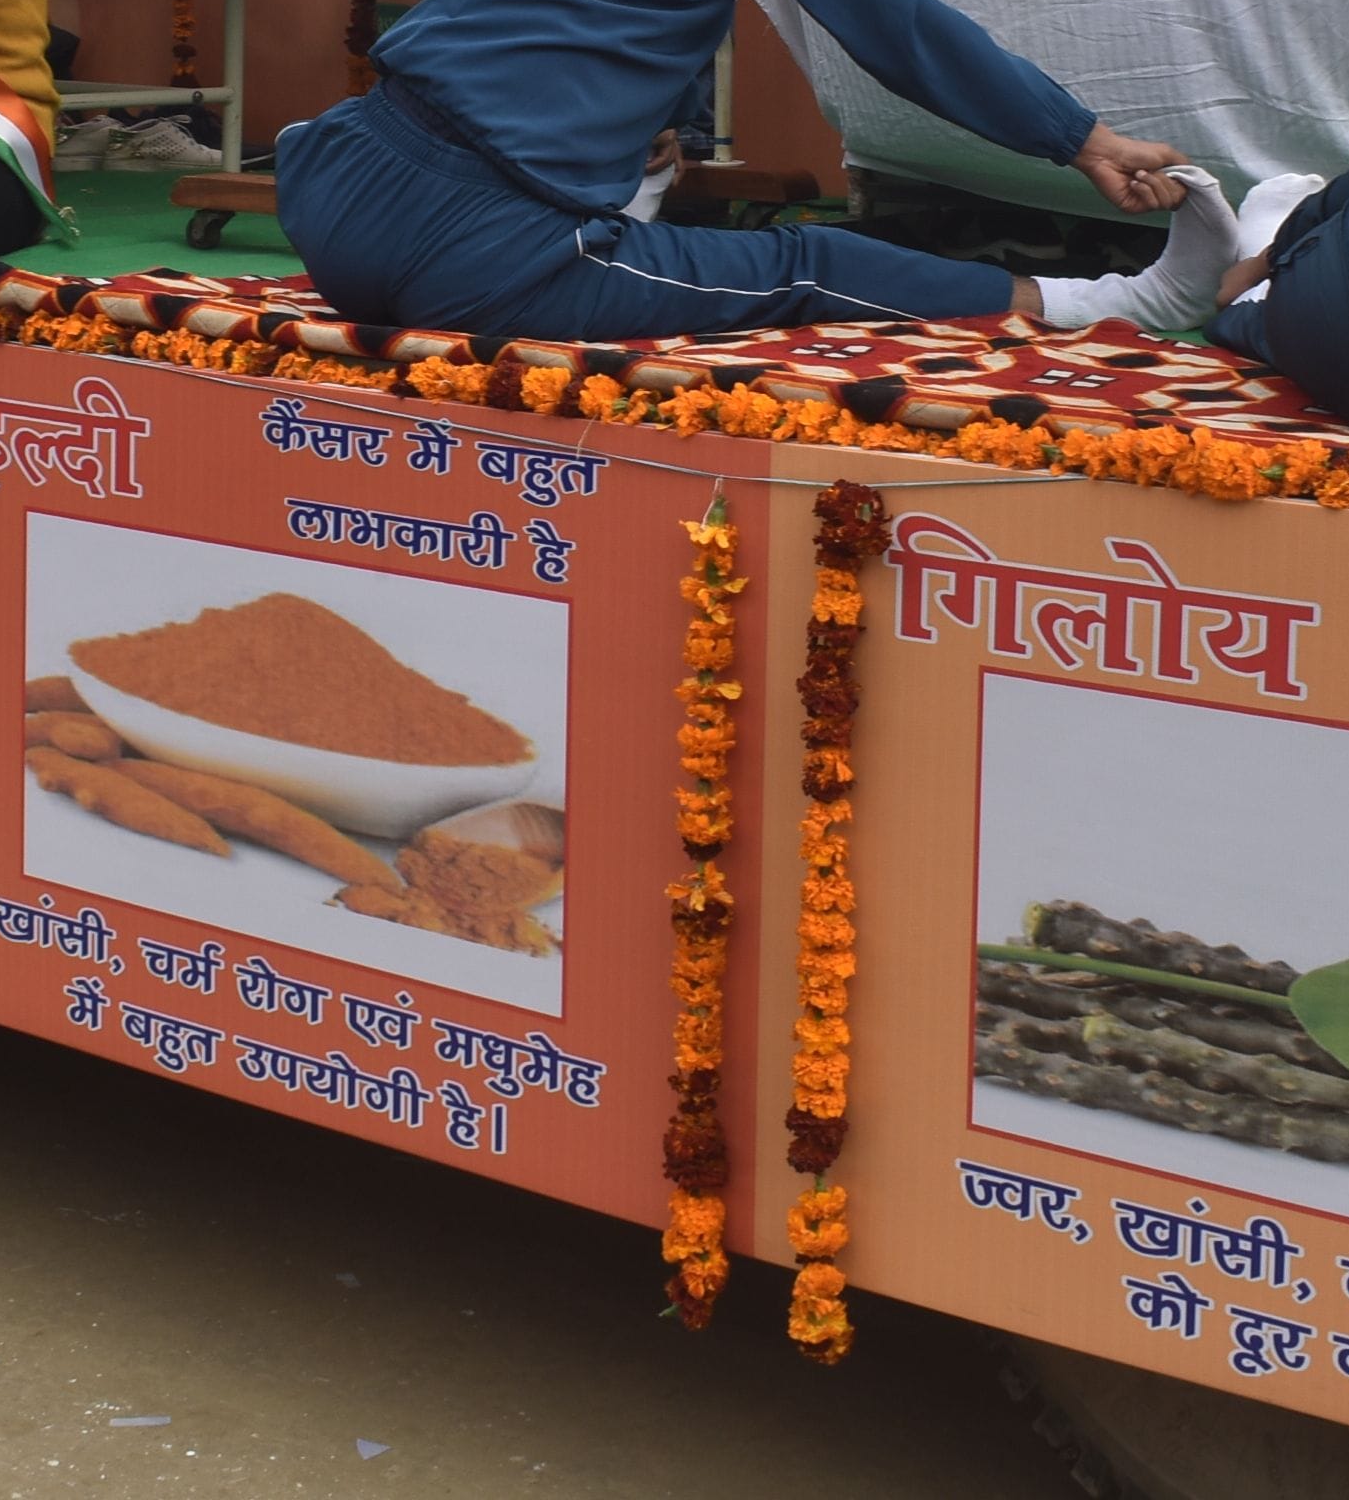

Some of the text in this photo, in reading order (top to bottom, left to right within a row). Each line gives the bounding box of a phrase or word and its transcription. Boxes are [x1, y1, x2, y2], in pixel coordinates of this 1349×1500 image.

[259, 398, 609, 507] कैंसर में बहुत
[284, 497, 576, 584] लाभकारी है
[886, 512, 1320, 699] गिलोय
[65, 977, 110, 1032] में
[122, 1001, 224, 1073] बहुत
[235, 1035, 432, 1129] उपयोगी
[141, 936, 224, 993] चर्म
[236, 955, 332, 1025] रोग
[344, 990, 420, 1050] एवं
[433, 1018, 607, 1109] मधुमेह
[955, 1158, 1092, 1244] ज्वर,
[1112, 1198, 1317, 1301] खांसी,
[1123, 1275, 1212, 1340] को
[1228, 1303, 1313, 1377] दूर
